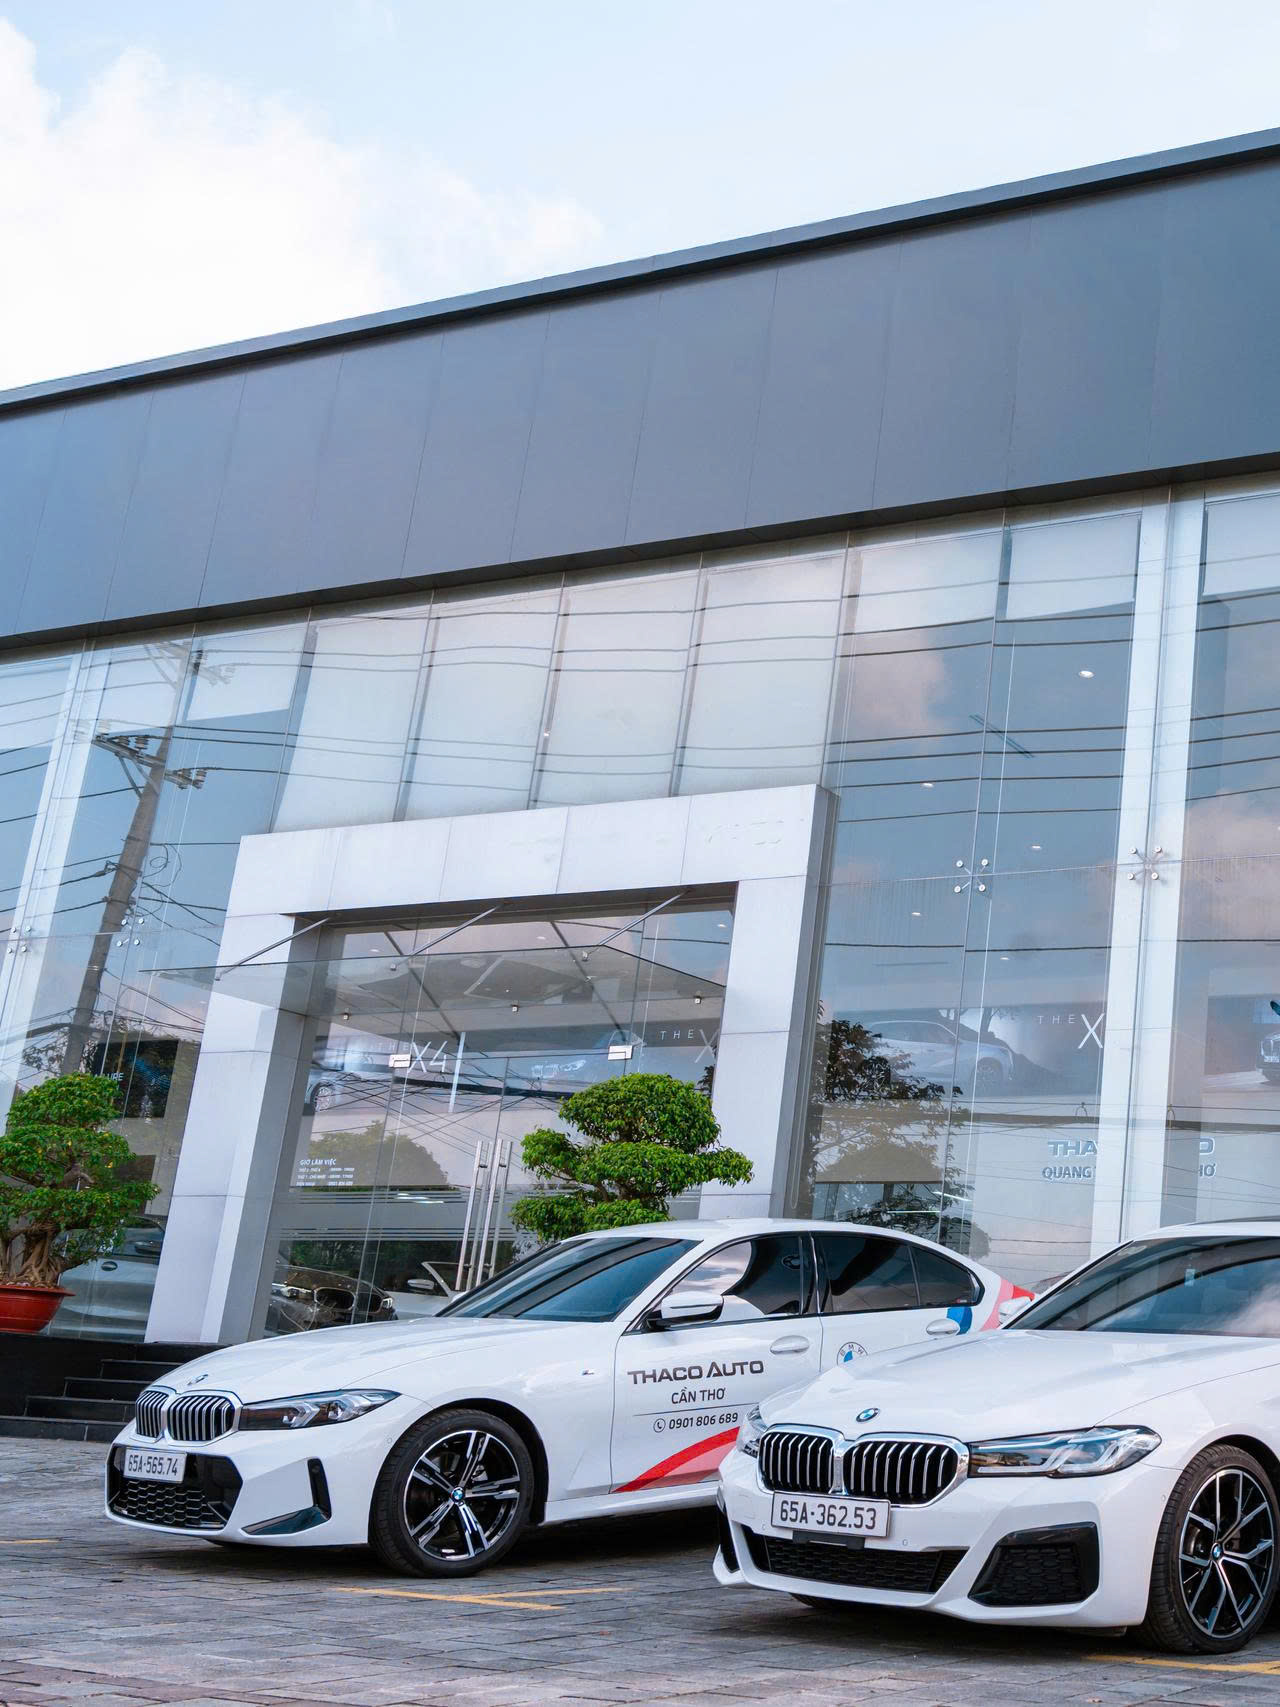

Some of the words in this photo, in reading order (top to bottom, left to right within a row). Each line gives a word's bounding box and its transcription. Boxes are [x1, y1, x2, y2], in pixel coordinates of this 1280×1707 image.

[1038, 1014, 1076, 1024] THE
[660, 1029, 694, 1040] THE
[407, 1040, 448, 1073] X4
[1042, 1165, 1093, 1180] QUANG
[627, 1365, 703, 1385] THACO
[707, 1360, 764, 1378] AUTO
[671, 1386, 697, 1404] CẦN
[699, 1387, 727, 1401] THƠ
[669, 1417, 694, 1430] 0901
[696, 1415, 717, 1427] 806
[718, 1412, 739, 1425] 689
[128, 1454, 179, 1476] 65A-565.74
[780, 1500, 877, 1530] 65A-362.53
